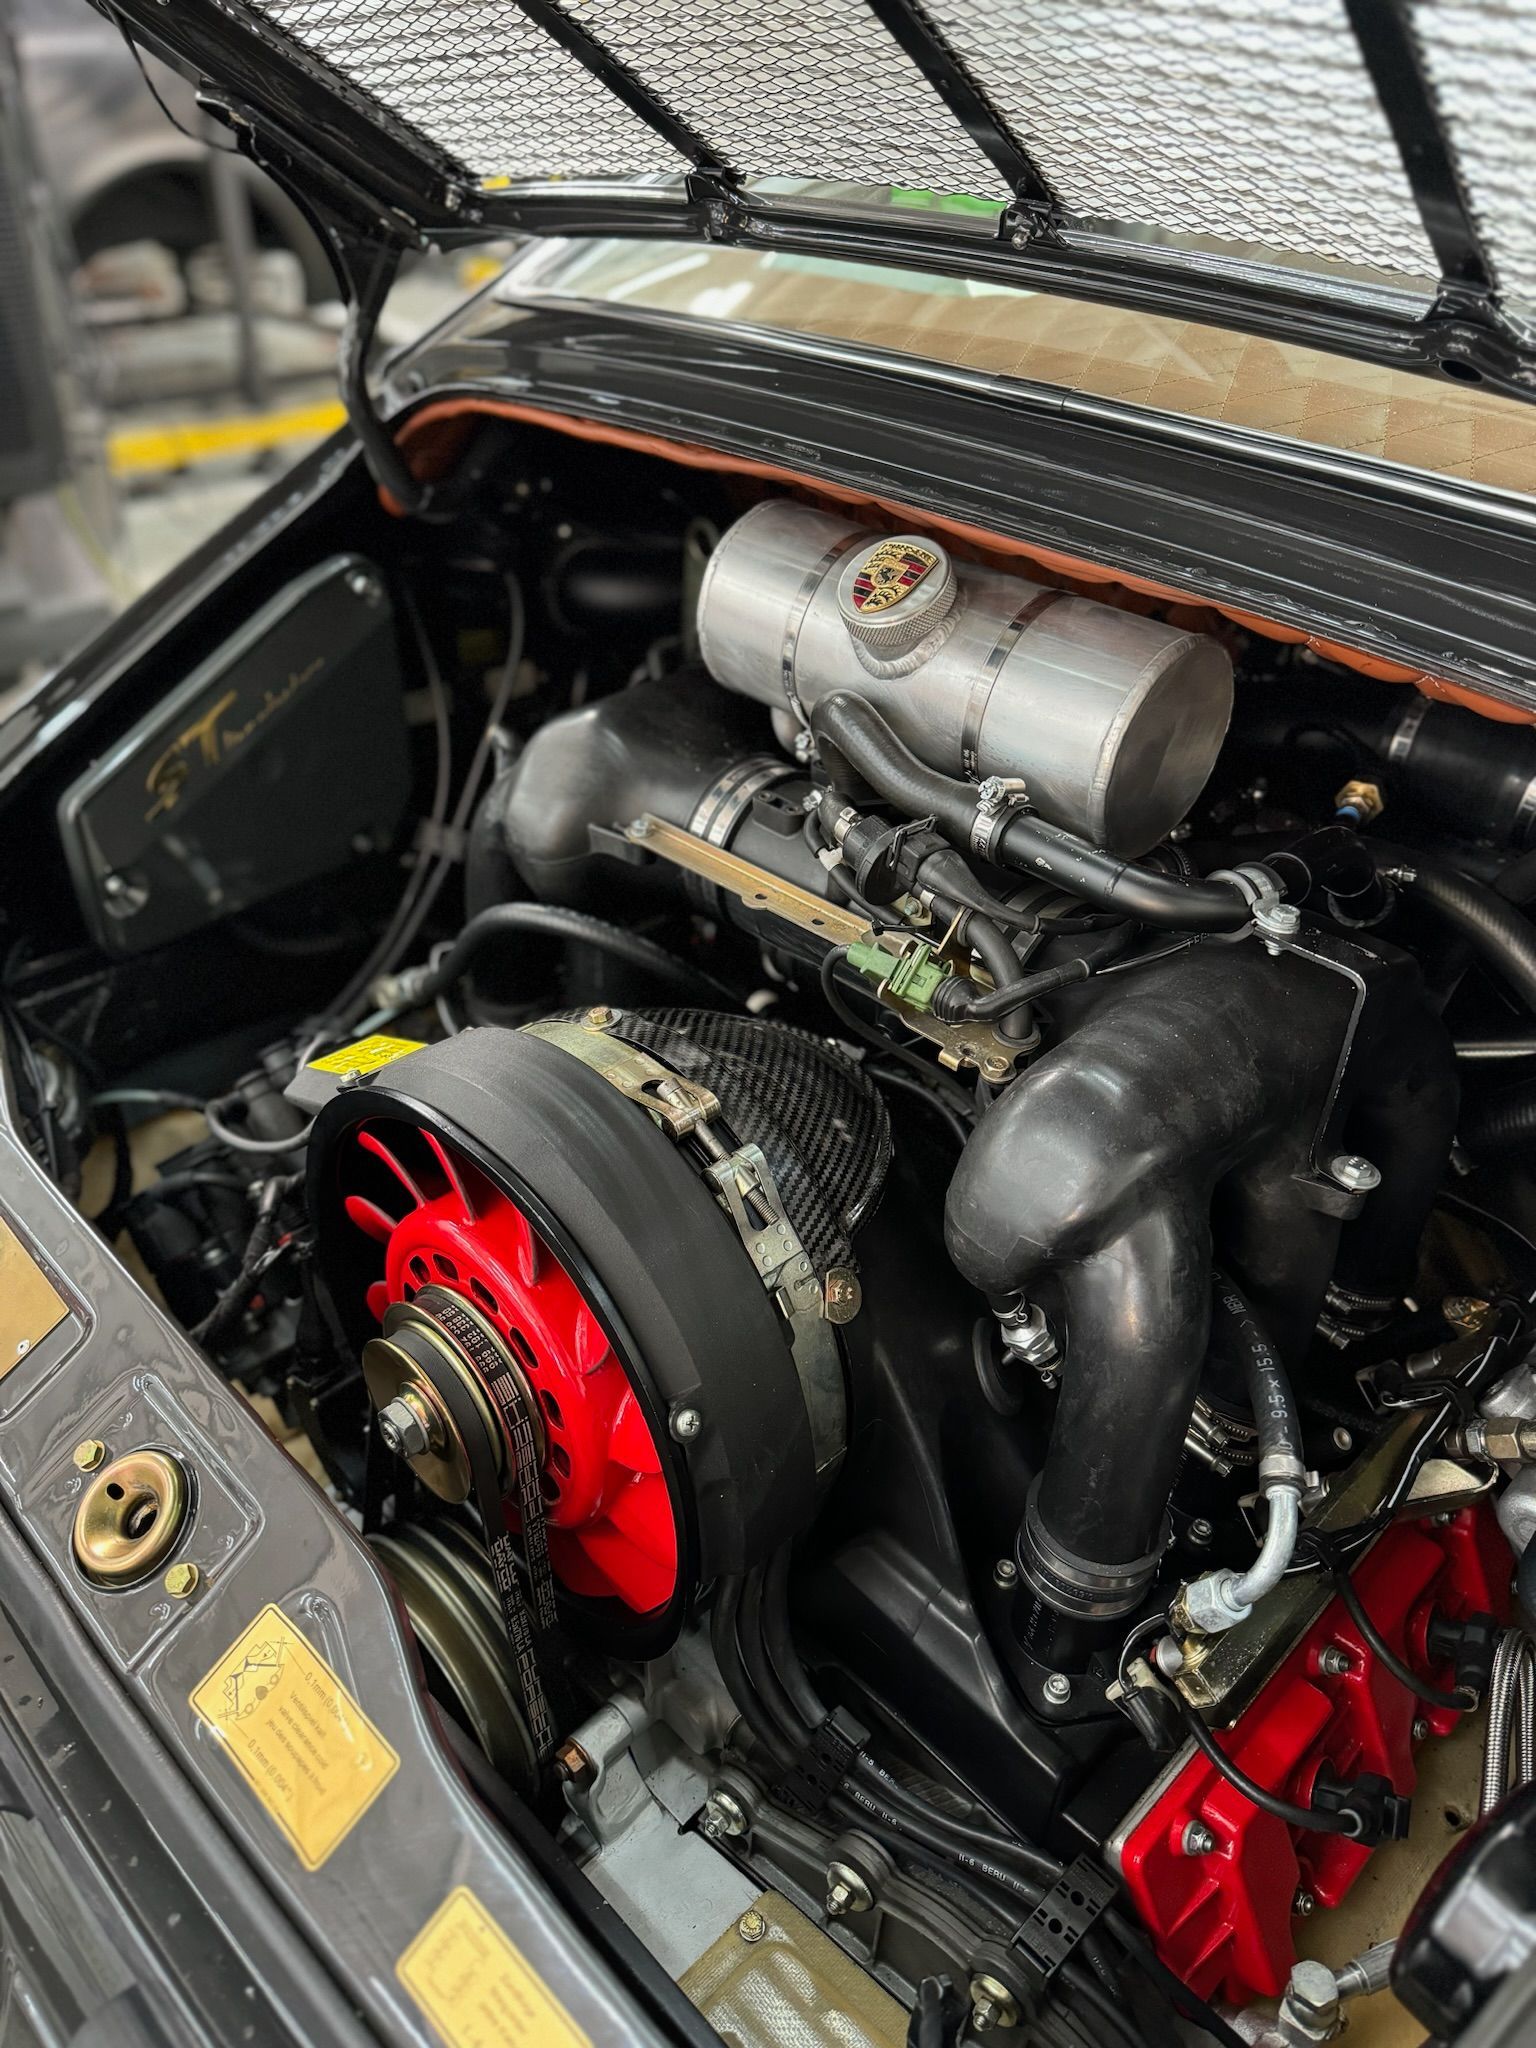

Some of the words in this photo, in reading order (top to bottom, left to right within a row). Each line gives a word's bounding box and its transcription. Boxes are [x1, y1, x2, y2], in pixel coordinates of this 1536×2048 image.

[452, 1314, 470, 1332] 338
[481, 1348, 499, 1370] 999
[981, 1864, 1007, 1882] BERU
